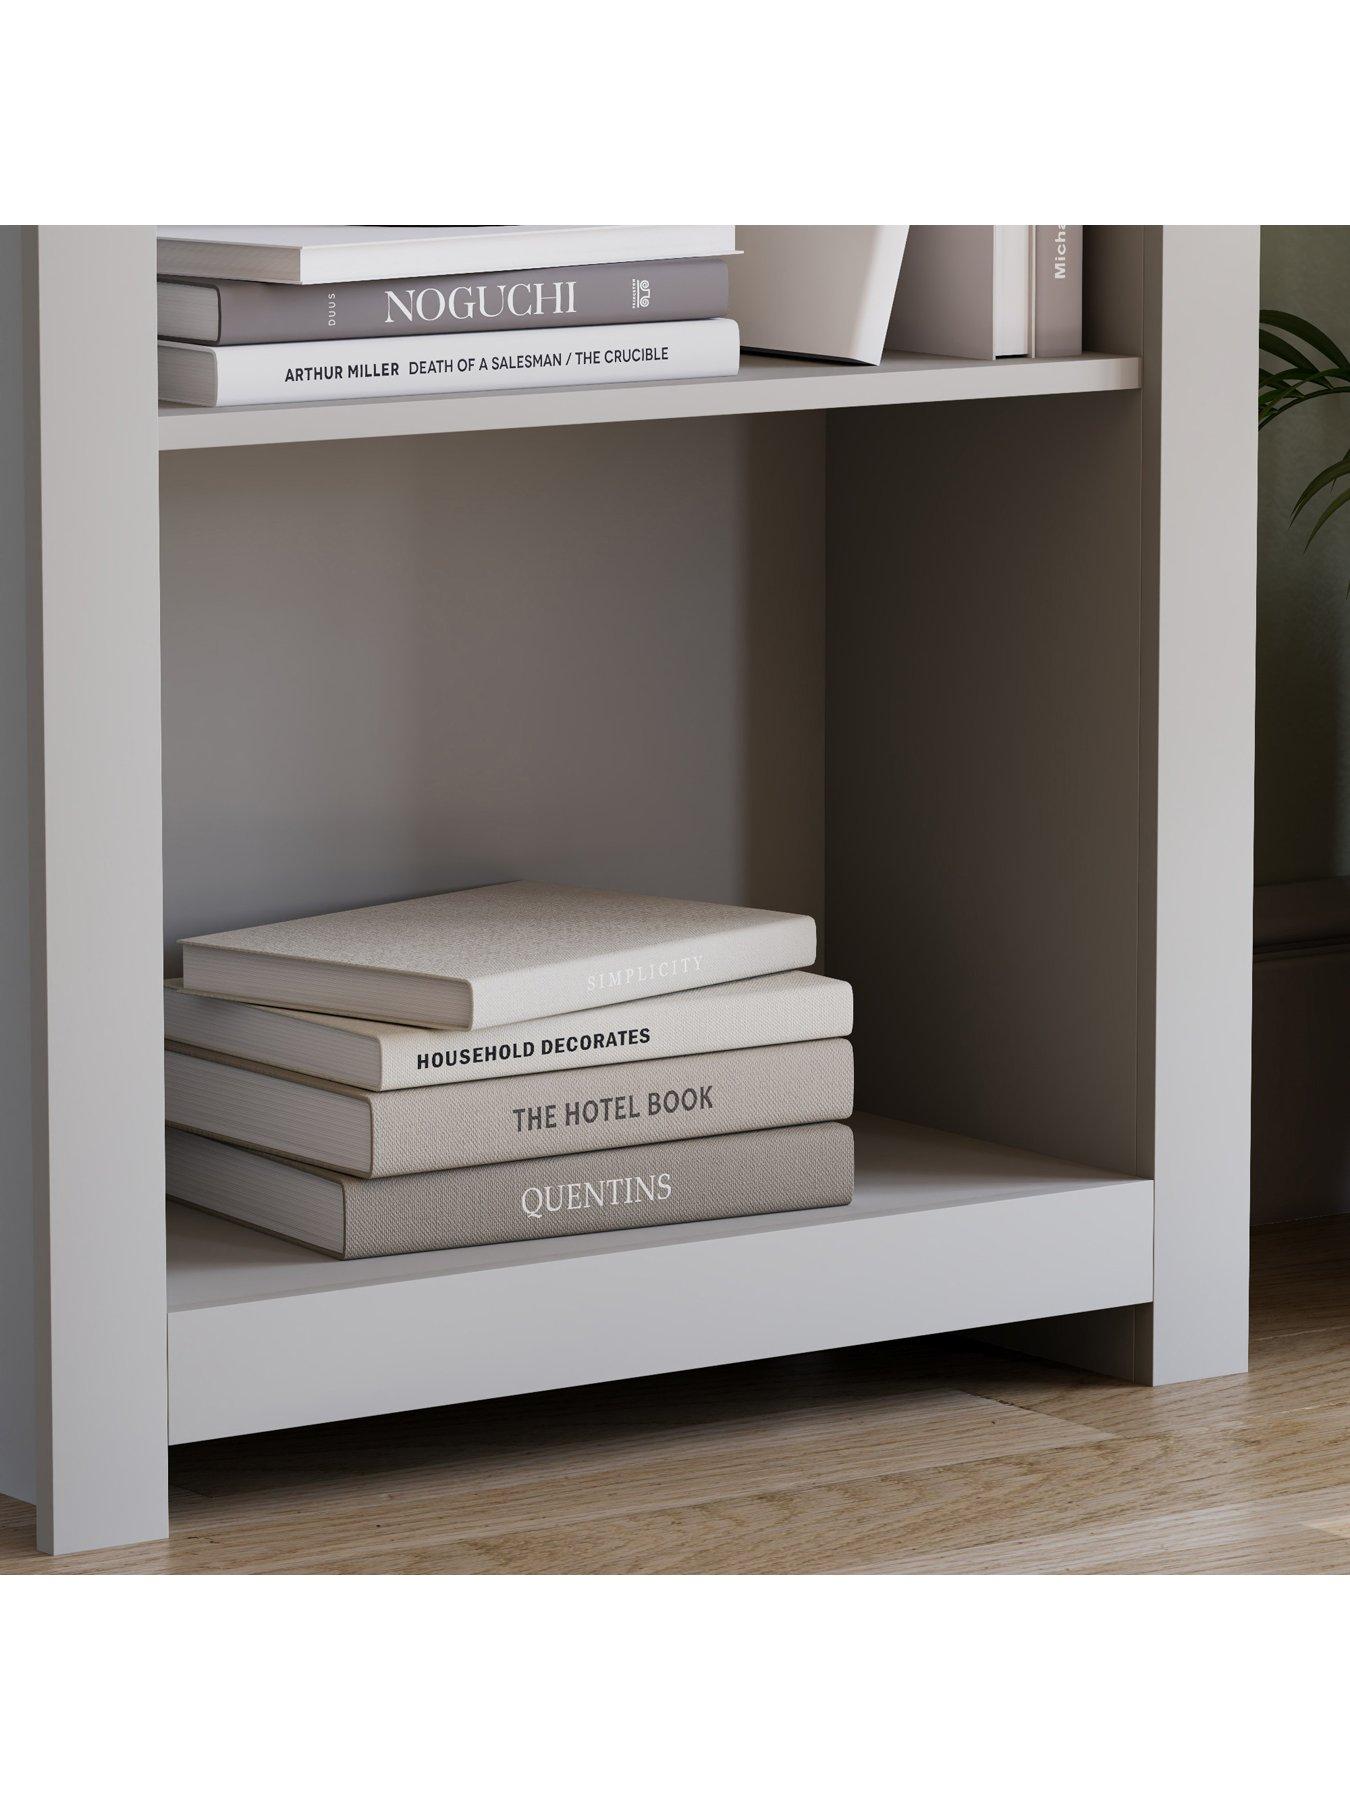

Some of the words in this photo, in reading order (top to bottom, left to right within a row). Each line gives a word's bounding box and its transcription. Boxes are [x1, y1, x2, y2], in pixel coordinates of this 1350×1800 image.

[328, 293, 336, 326] DUUS
[384, 281, 577, 324] NOGUCHI
[285, 365, 343, 382] ARTHUR
[348, 362, 399, 378] MILLER
[409, 359, 453, 375] DEATH
[457, 358, 475, 372] OF
[478, 357, 488, 371] A
[491, 353, 562, 370] SALESMAN
[565, 352, 572, 366] /
[575, 351, 601, 364] THE
[604, 346, 669, 364] CRUCIBLE
[586, 955, 704, 992] SIMPLICITY
[417, 1040, 535, 1070] HOUSEHOLD
[541, 1027, 651, 1056] DECORATES
[512, 1104, 557, 1132] THE
[565, 1094, 640, 1126] HOTEL
[648, 1085, 713, 1115] BOOK
[521, 1173, 672, 1219] QUENTINS
